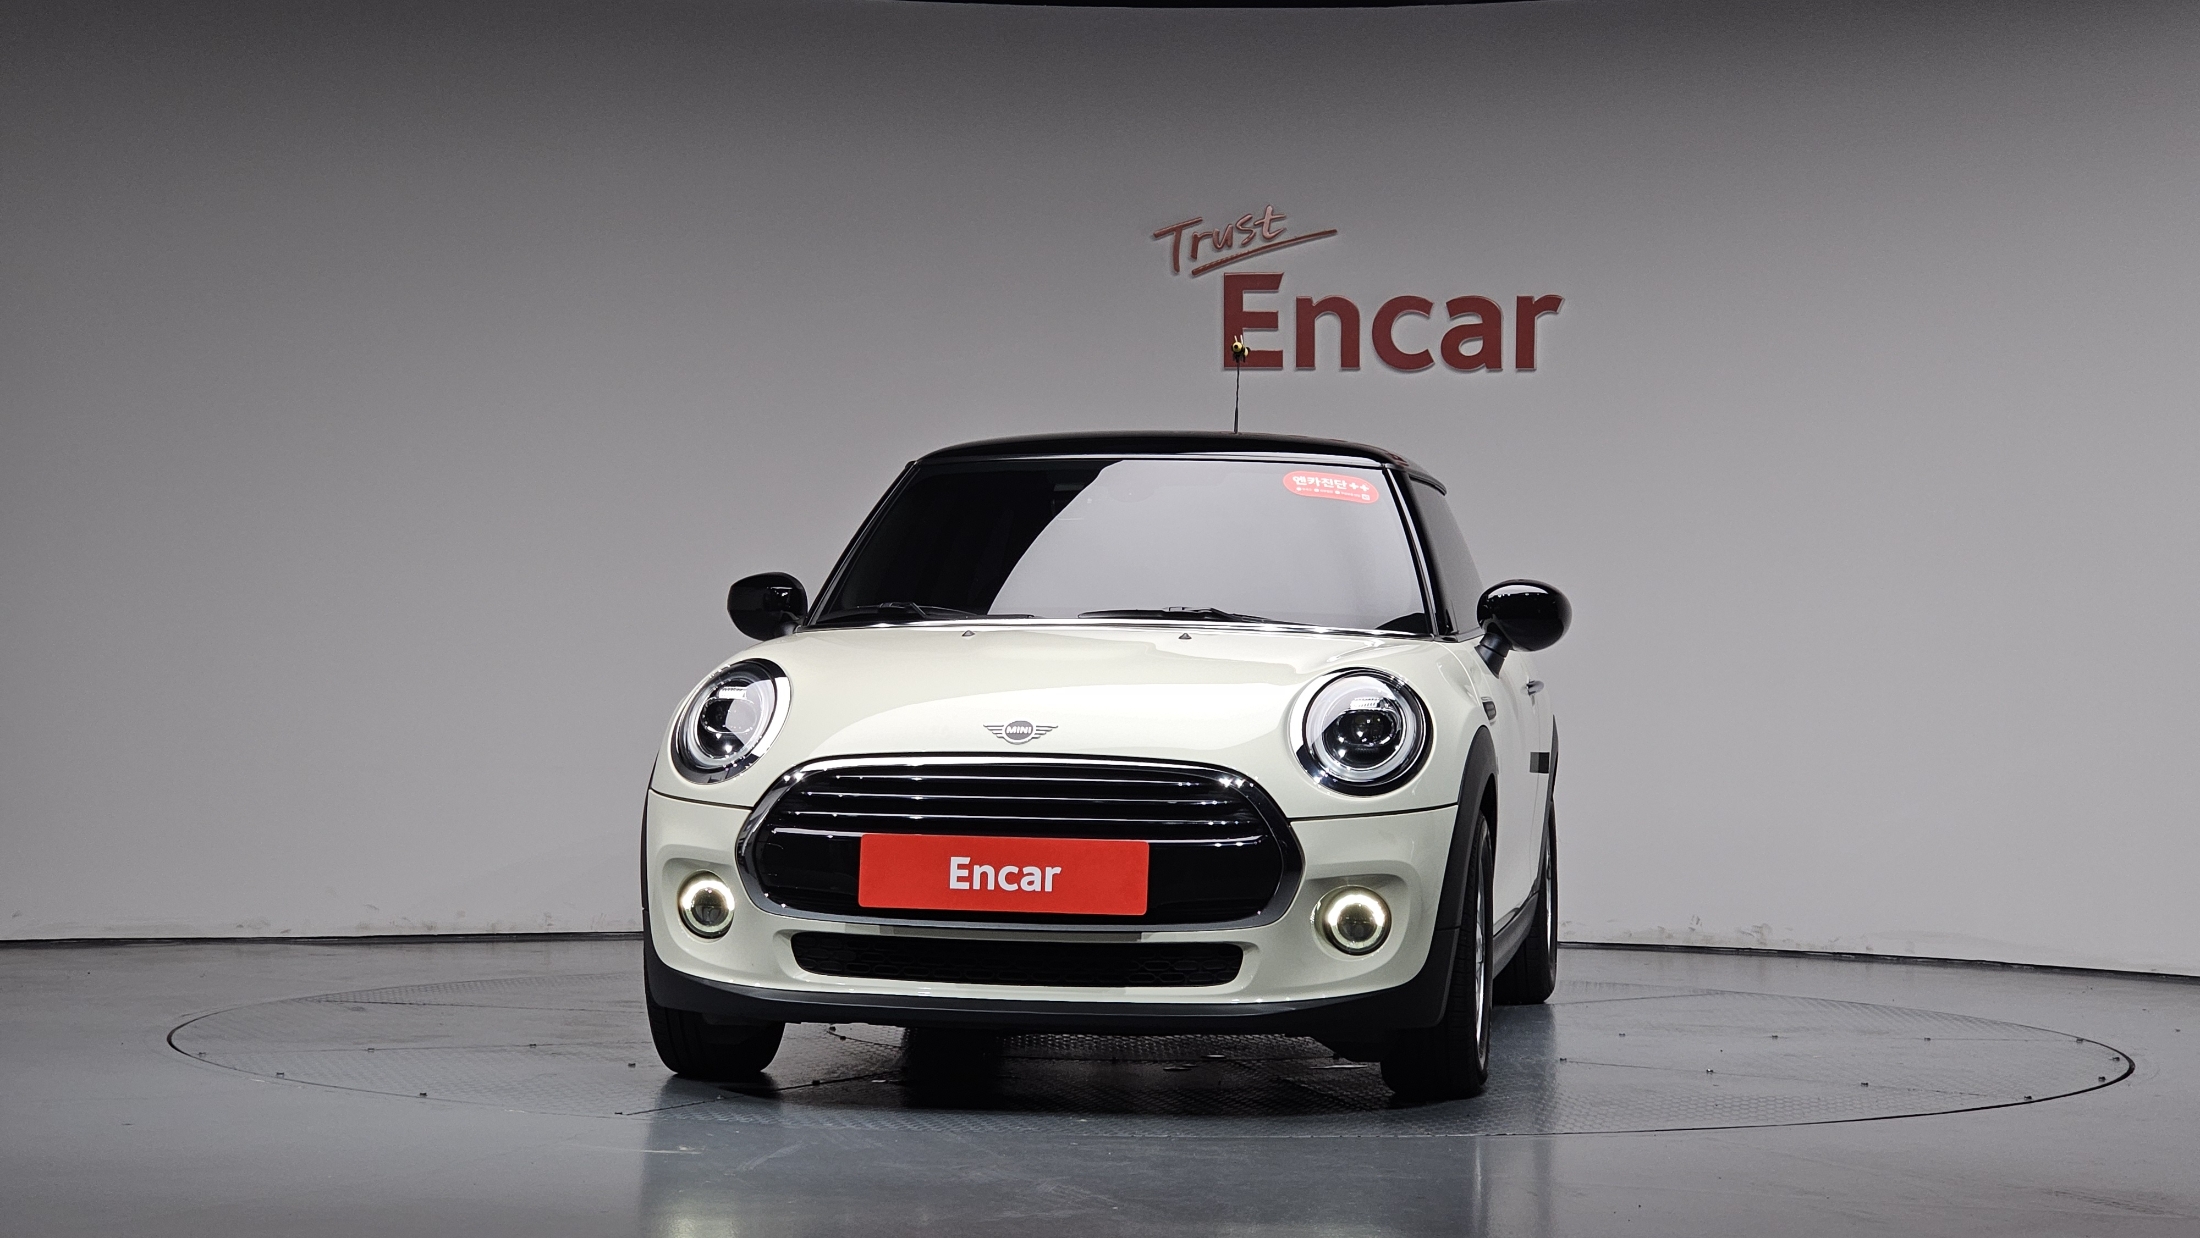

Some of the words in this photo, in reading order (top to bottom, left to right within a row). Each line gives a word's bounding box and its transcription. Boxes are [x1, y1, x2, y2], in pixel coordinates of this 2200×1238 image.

[1153, 204, 1287, 273] Trust
[1223, 271, 1565, 372] Encar
[1006, 725, 1031, 734] MINI
[949, 856, 1062, 892] Encar
